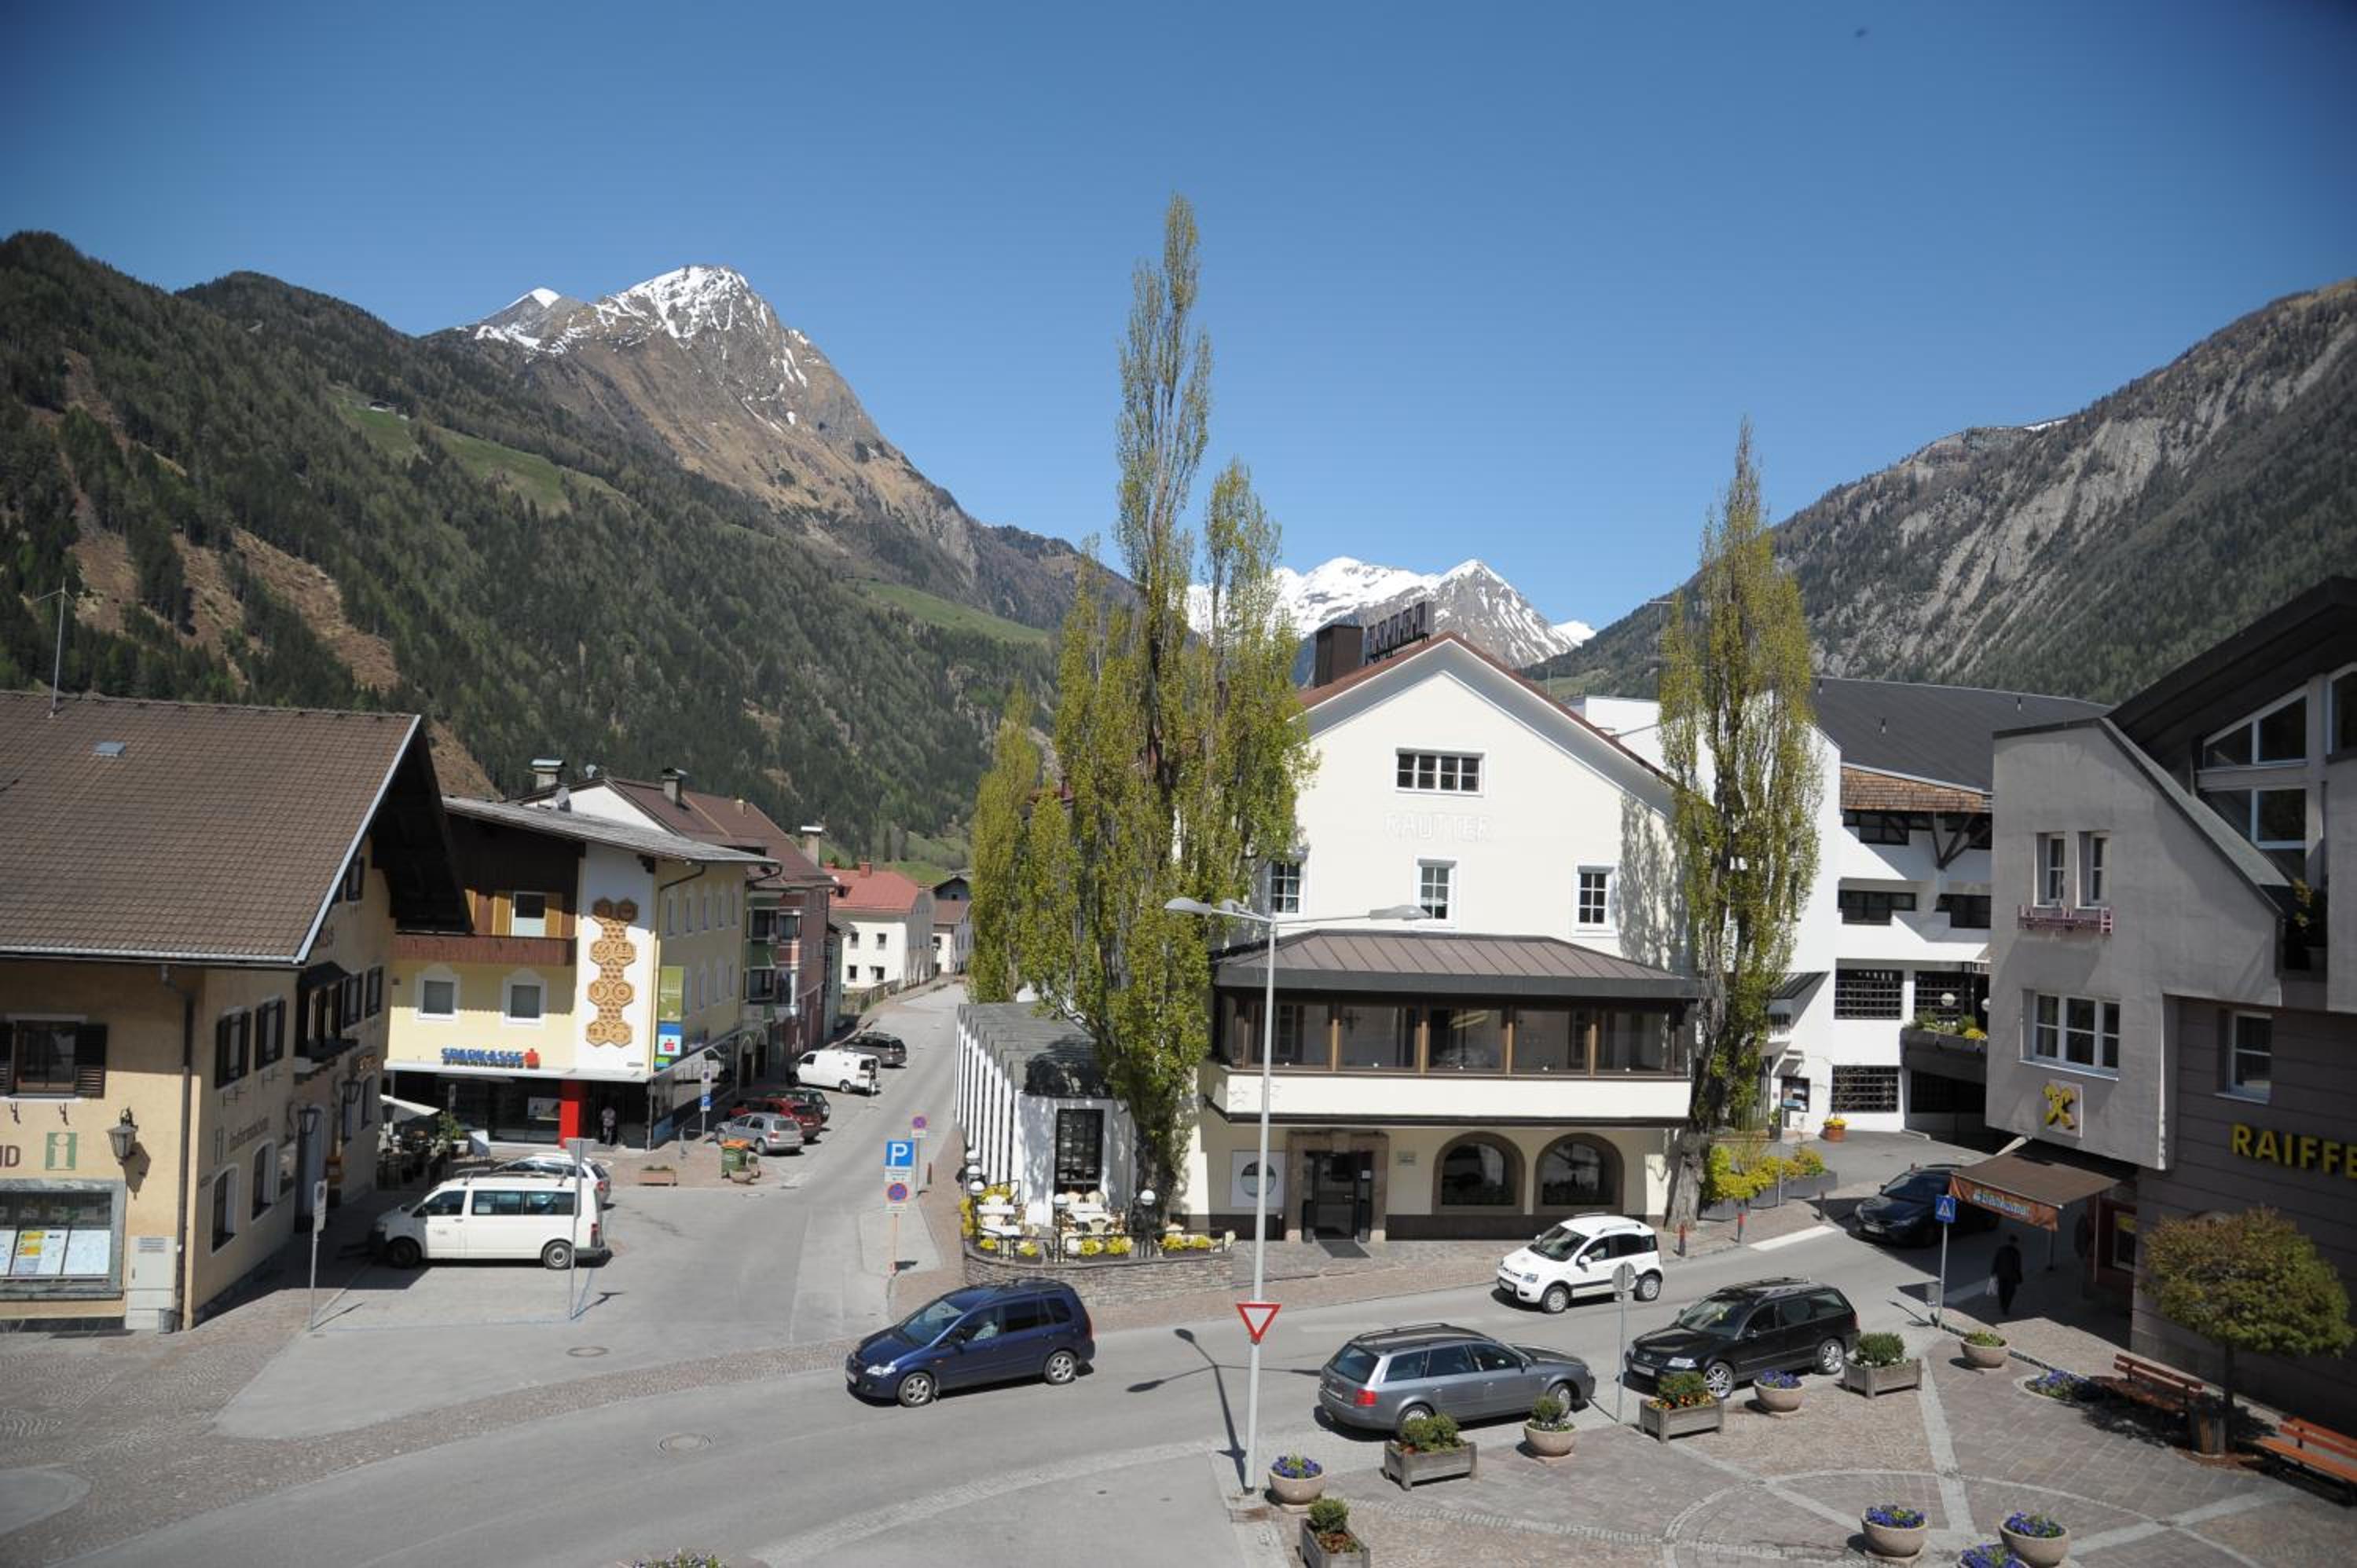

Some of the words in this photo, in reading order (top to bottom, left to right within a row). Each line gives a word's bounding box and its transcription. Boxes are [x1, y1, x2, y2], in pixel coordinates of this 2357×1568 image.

[441, 1047, 523, 1064] SPARKASSE
[0, 1145, 21, 1168] D
[891, 1142, 908, 1166] P
[2231, 1122, 2357, 1179] RAIFFE
